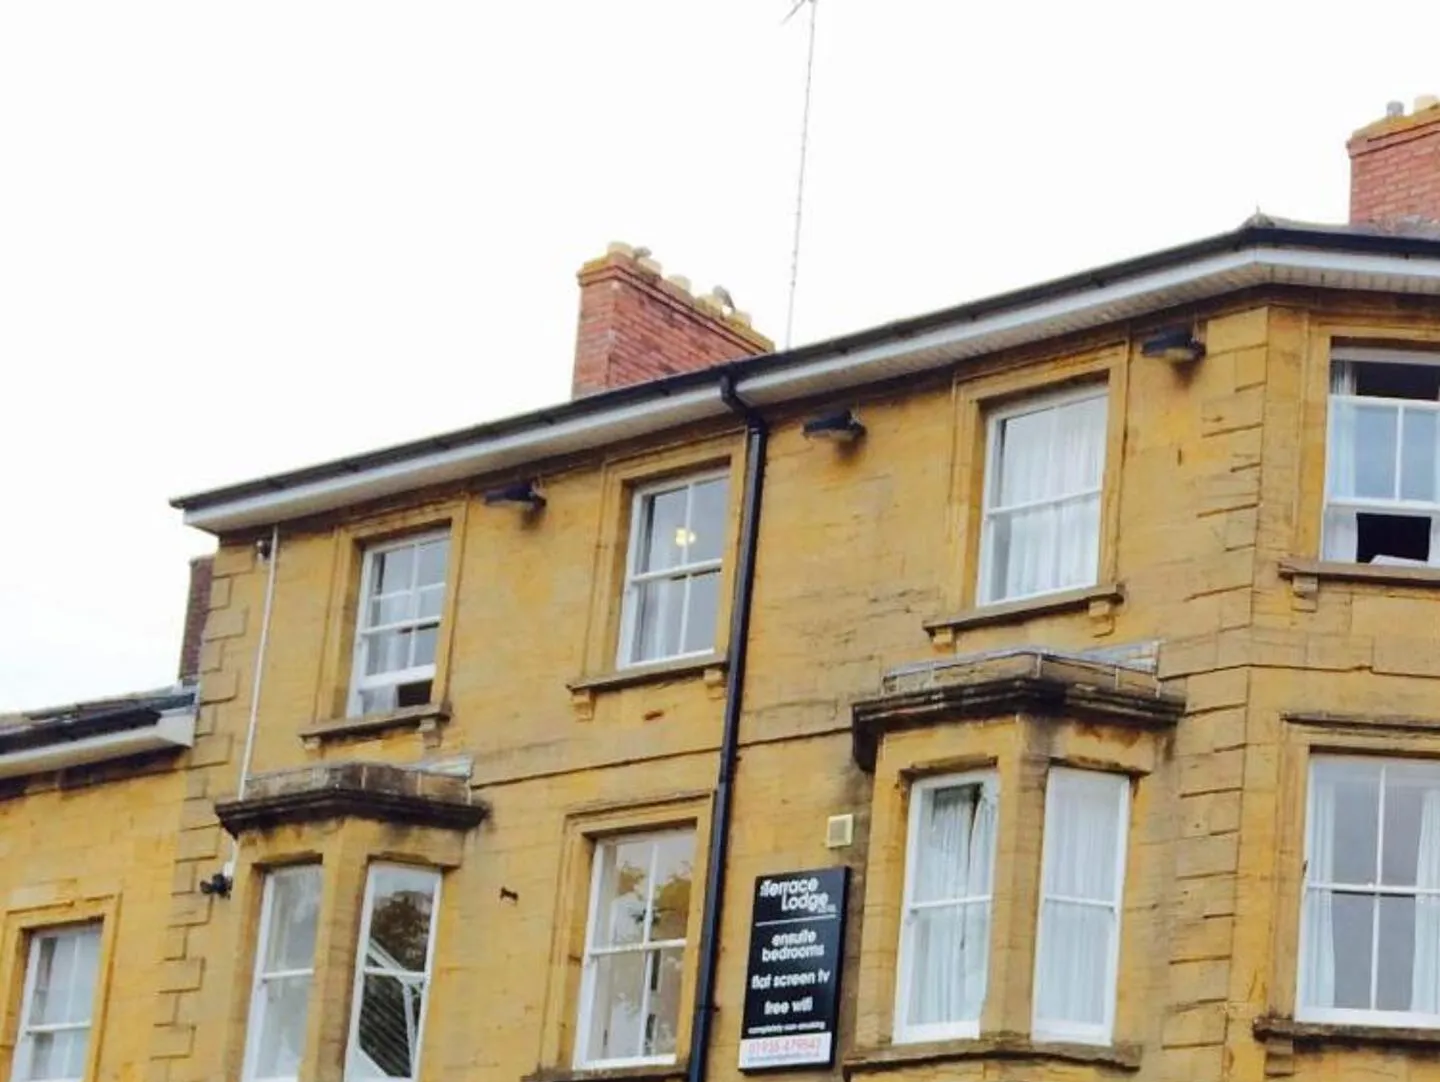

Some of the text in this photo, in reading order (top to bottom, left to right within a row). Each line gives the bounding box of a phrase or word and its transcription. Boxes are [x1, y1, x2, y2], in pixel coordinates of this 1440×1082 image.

[763, 877, 818, 897] Terrace
[781, 892, 828, 911] Lodge
[771, 929, 816, 946] ensuite
[762, 943, 824, 962] bedrooms
[752, 968, 830, 989] flat screen tv
[764, 996, 813, 1015] free wifi
